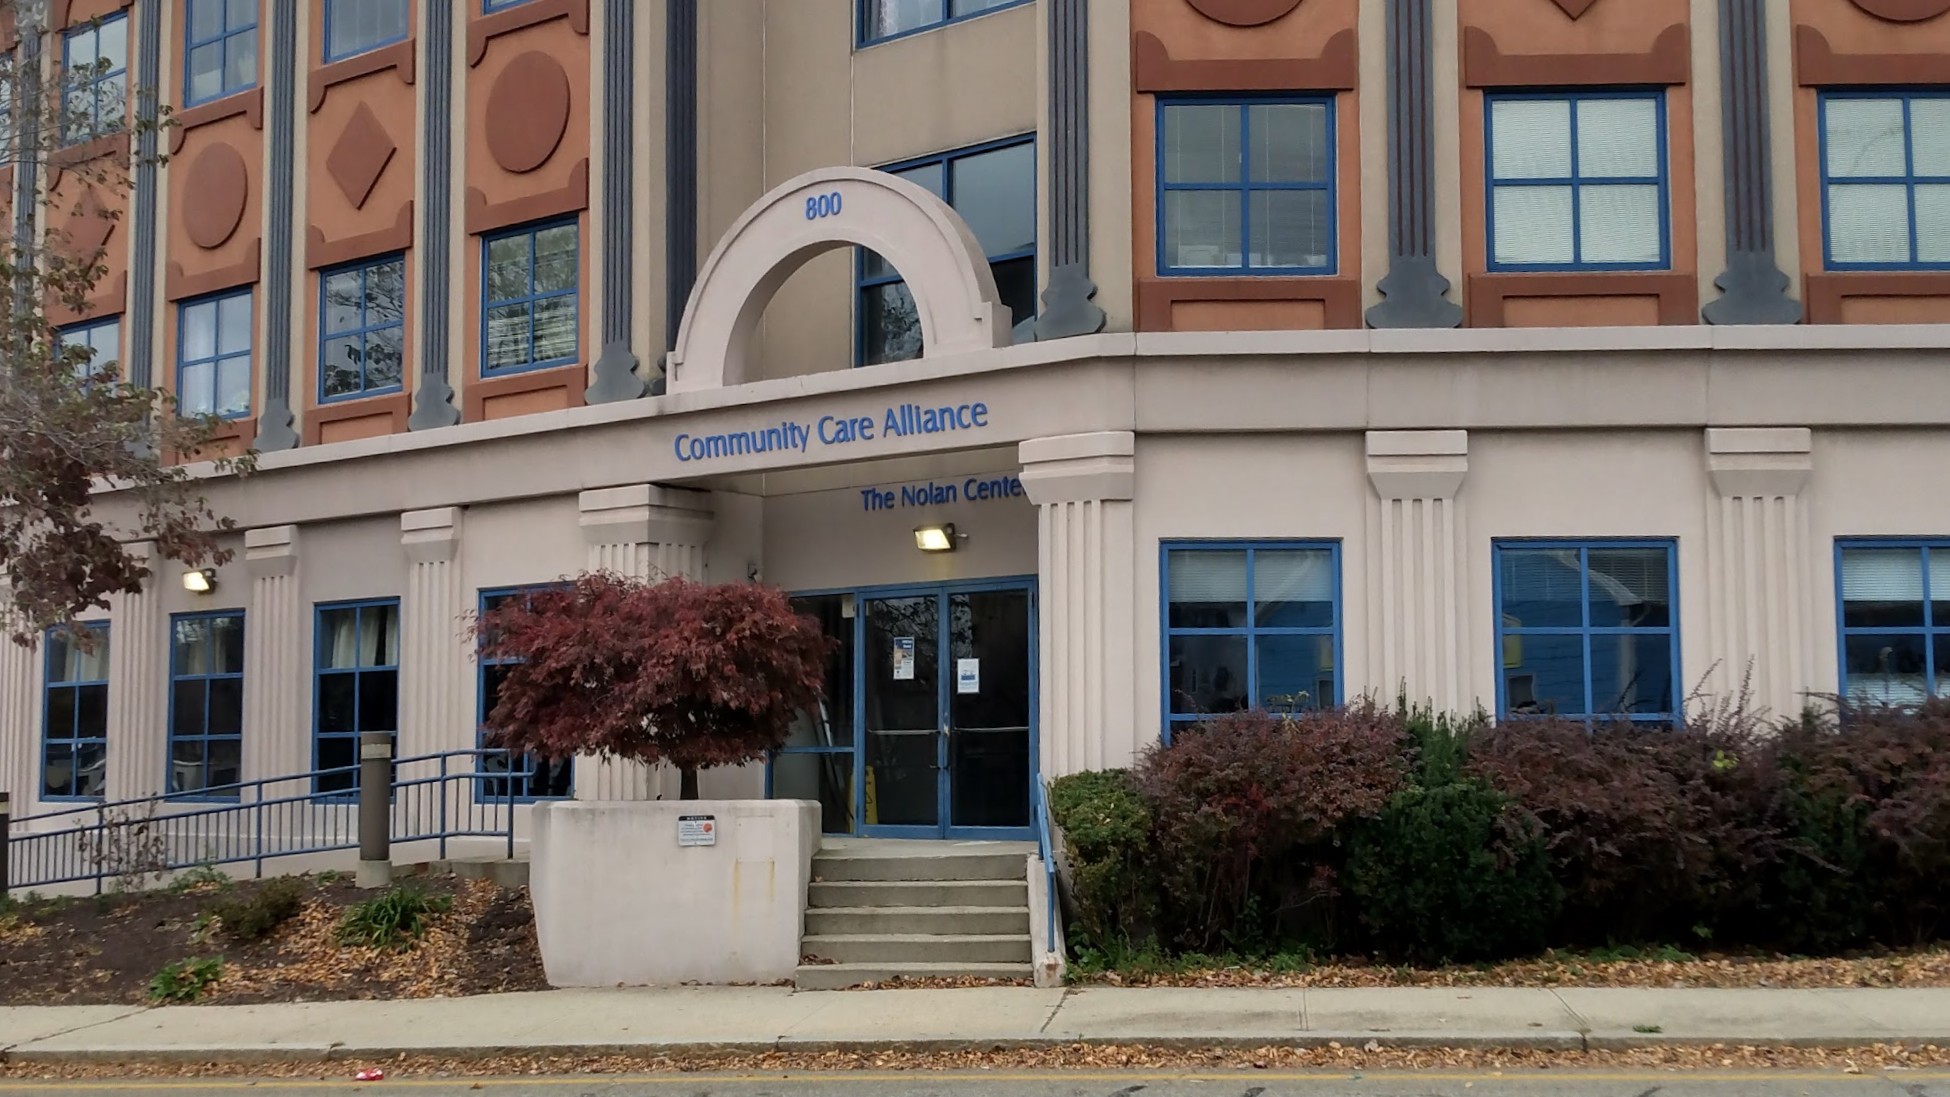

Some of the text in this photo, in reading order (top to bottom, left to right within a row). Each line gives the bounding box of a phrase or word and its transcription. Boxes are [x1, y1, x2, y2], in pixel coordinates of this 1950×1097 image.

[805, 192, 842, 220] 800
[674, 402, 988, 461] Community Care Alliance
[861, 476, 1026, 512] The Nolan Cente
